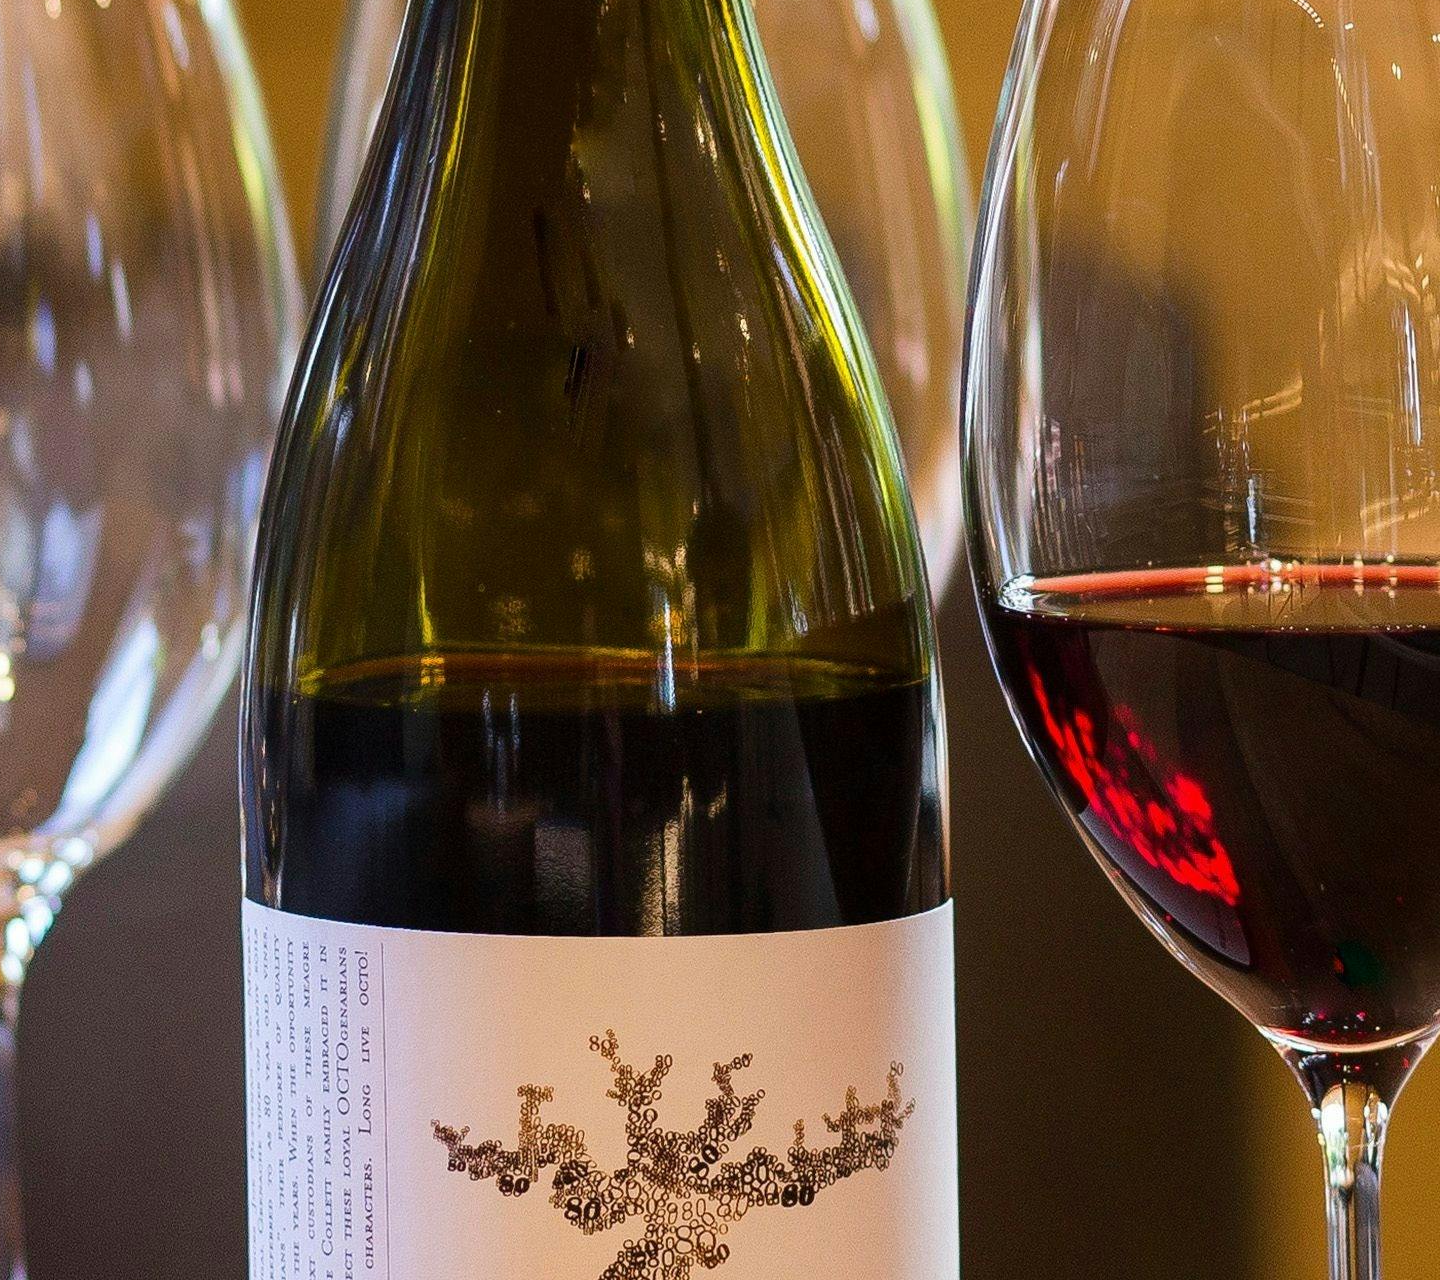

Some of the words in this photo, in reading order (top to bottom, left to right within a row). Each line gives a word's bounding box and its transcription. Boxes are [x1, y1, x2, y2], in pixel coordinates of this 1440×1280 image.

[274, 934, 282, 1006] QUALITY
[302, 941, 310, 1008] MEAGRE
[319, 944, 327, 964] IN
[354, 950, 369, 1006] OCTO!
[287, 936, 296, 1053] OPPORTUNITY
[320, 974, 328, 992] IT
[276, 1022, 282, 1044] OF
[304, 1026, 312, 1078] THESE
[321, 1005, 330, 1093] EMBRACED
[362, 1026, 370, 1063] LIVE
[264, 1095, 272, 1118] 80
[276, 1061, 284, 1140] PEDIGREE
[305, 1094, 313, 1118] OF
[267, 1131, 272, 1150] AS
[323, 1105, 331, 1166] FAMILY
[342, 1126, 351, 1178] LOYAL
[267, 1164, 273, 1186] TO
[306, 1135, 315, 1240] CUSTODIANS
[344, 1188, 352, 1240] THESE
[364, 1158, 374, 1269] CHARACTERS.
